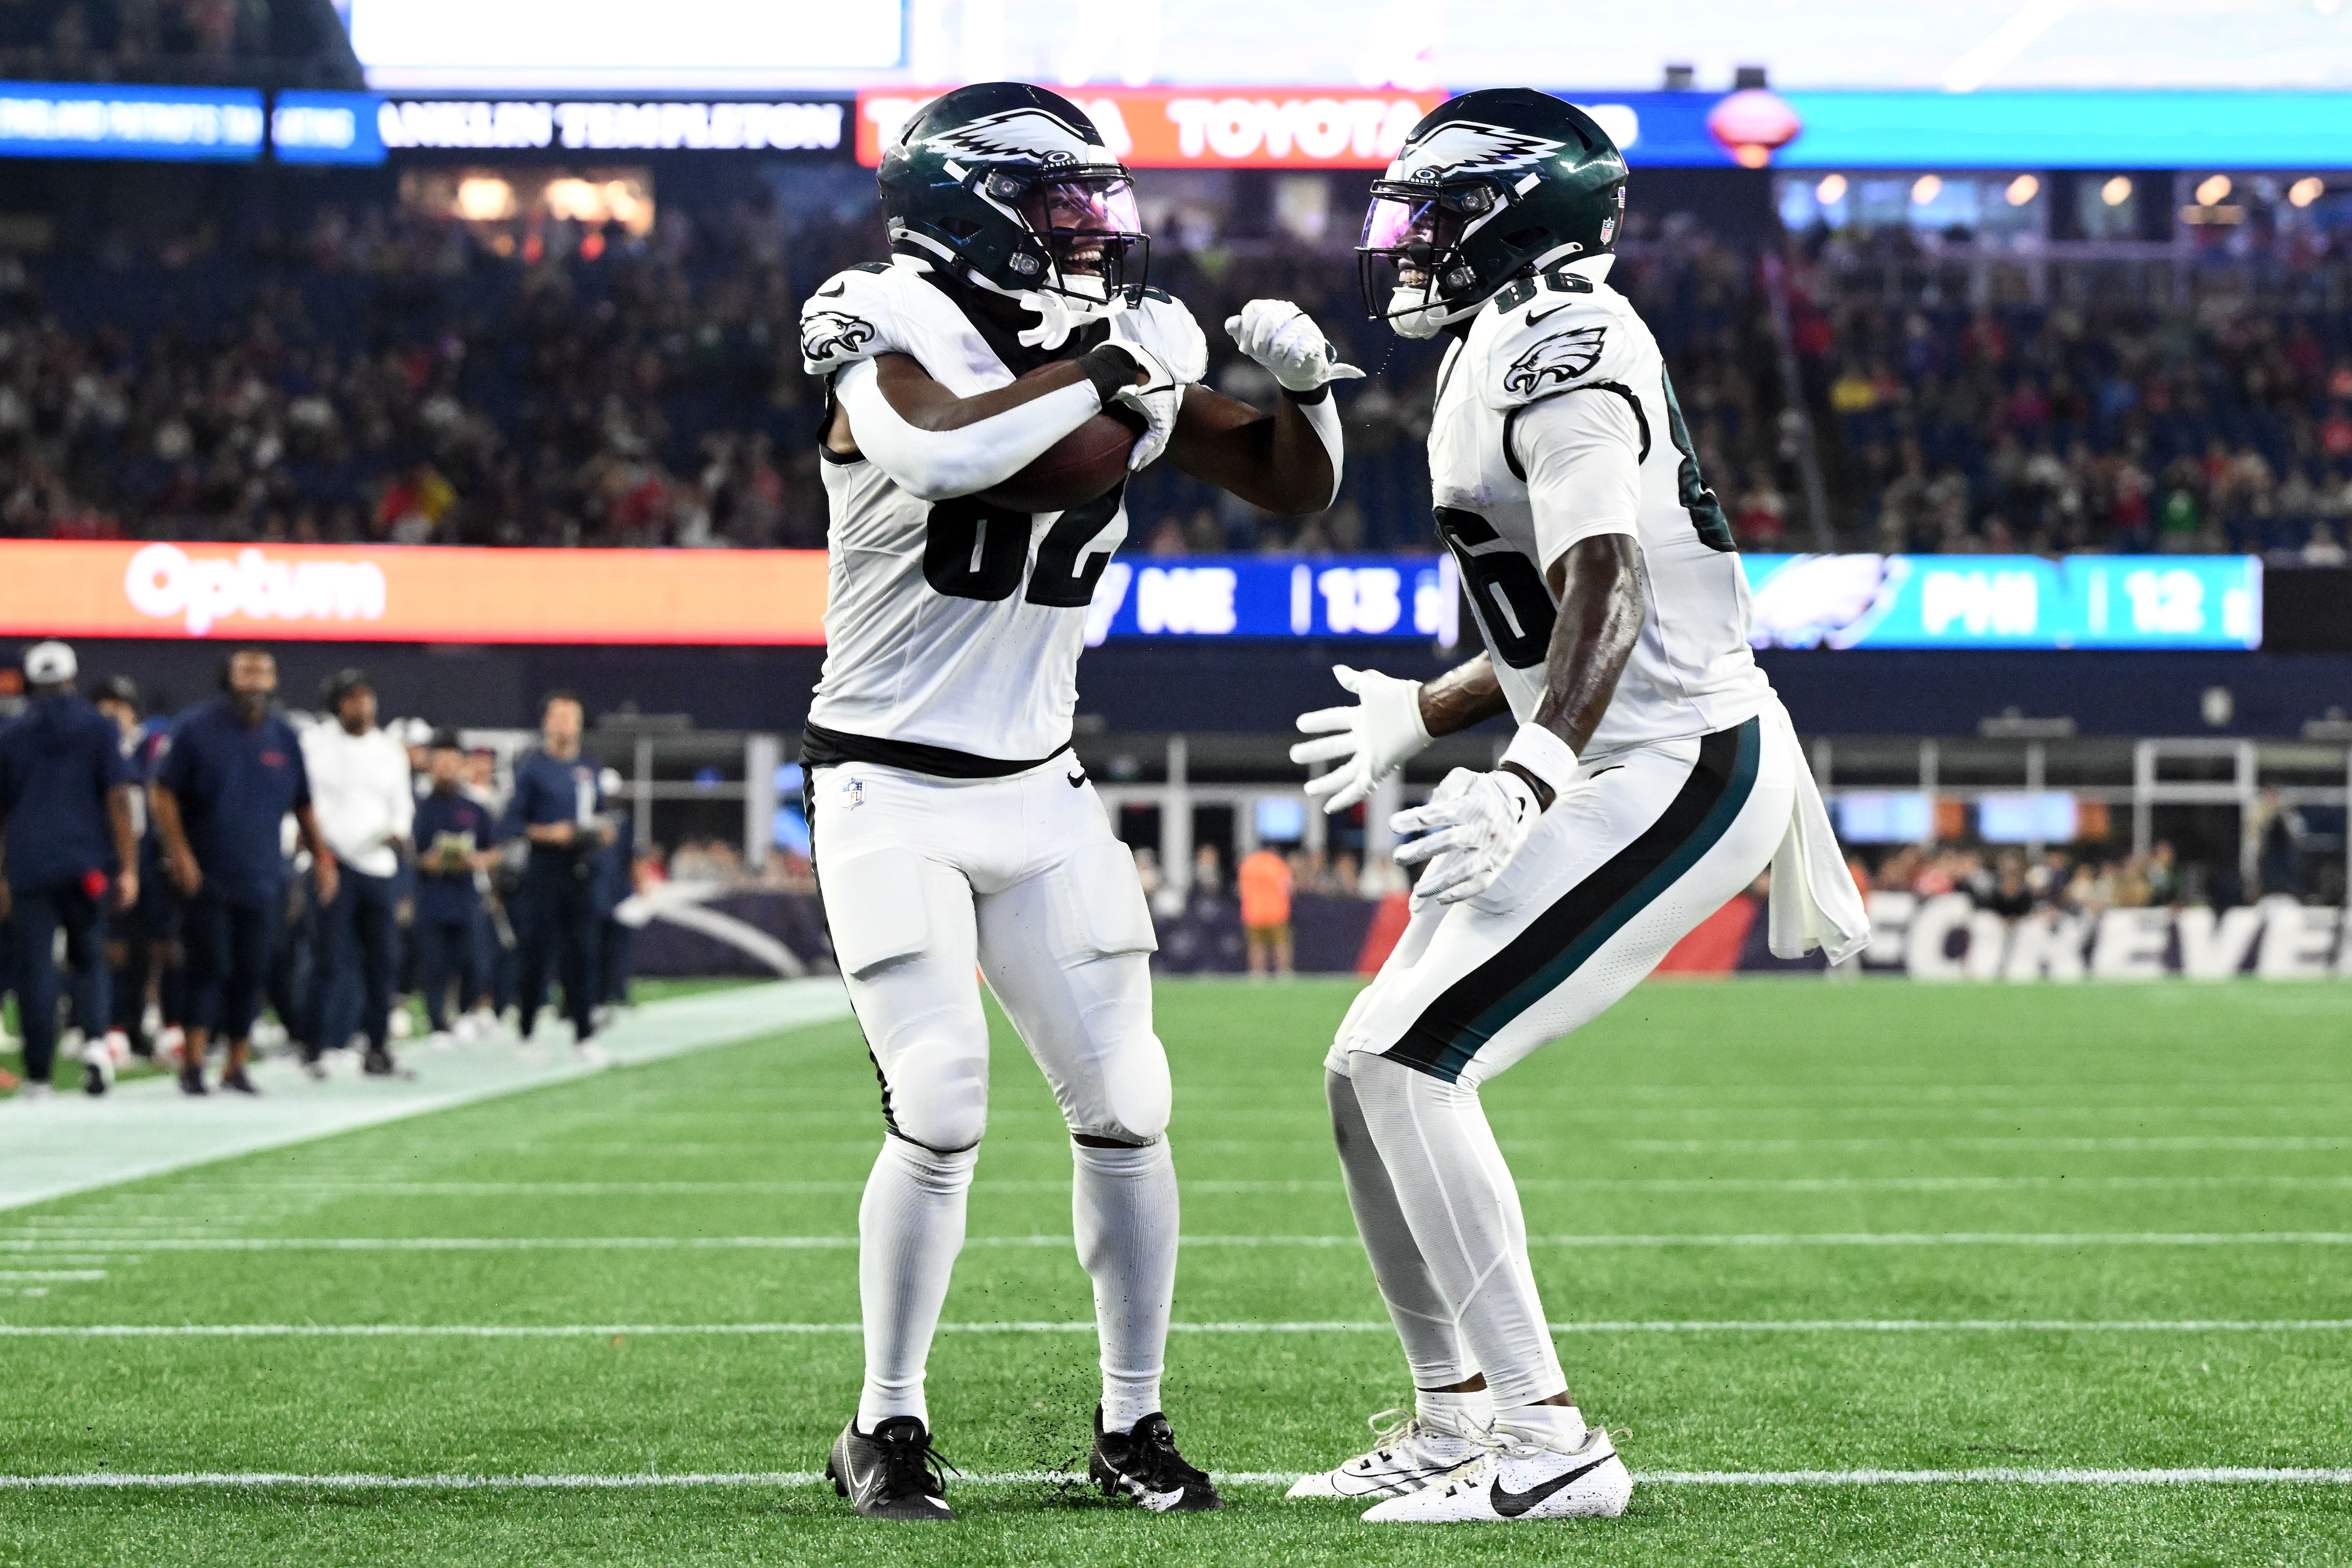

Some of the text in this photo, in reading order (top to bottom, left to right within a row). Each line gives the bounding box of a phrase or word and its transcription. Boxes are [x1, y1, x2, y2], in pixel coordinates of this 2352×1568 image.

[555, 102, 843, 149] TEMPLETON
[1166, 98, 1425, 158] TOYOTA
[1043, 159, 1078, 168] OAKLEY
[126, 544, 385, 635] Optum
[1138, 567, 1237, 635] NE
[2124, 569, 2204, 634] 12
[1826, 889, 2352, 983] FOREVE
